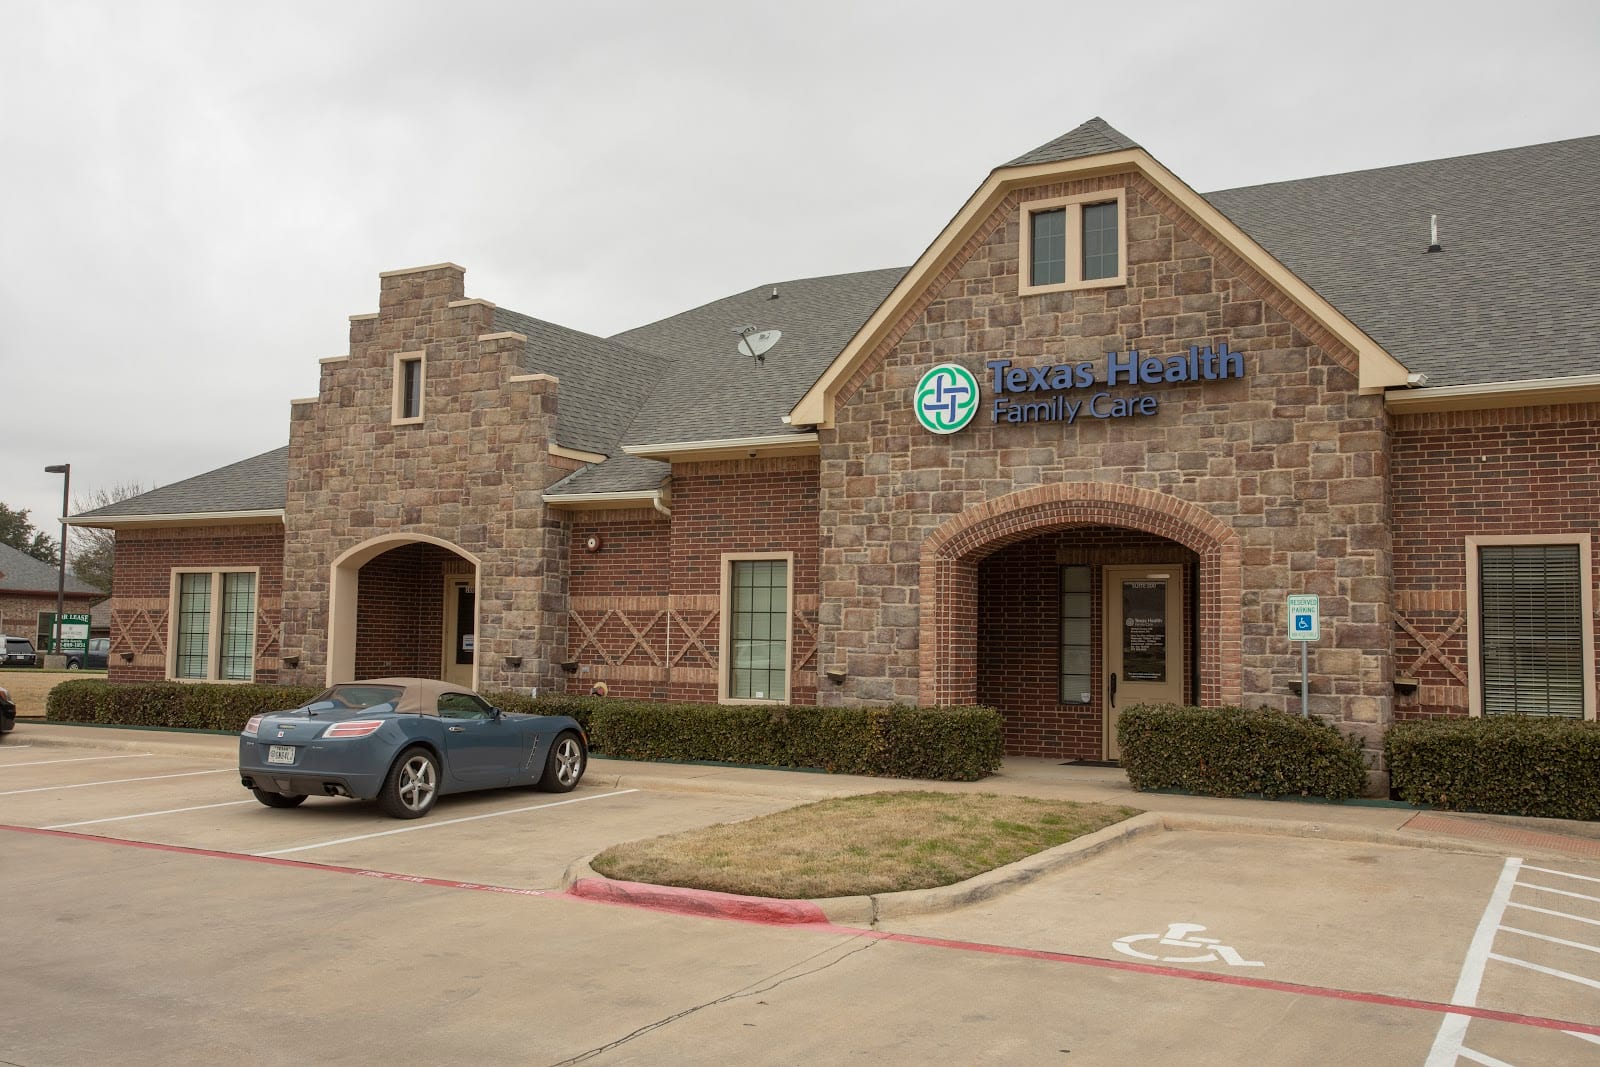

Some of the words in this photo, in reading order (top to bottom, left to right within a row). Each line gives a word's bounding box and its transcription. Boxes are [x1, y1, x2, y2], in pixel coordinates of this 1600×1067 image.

[987, 359, 1095, 394] Texas
[1106, 343, 1245, 386] Health
[991, 398, 1083, 424] Family
[1089, 392, 1158, 419] Care
[70, 614, 89, 622] LEASE
